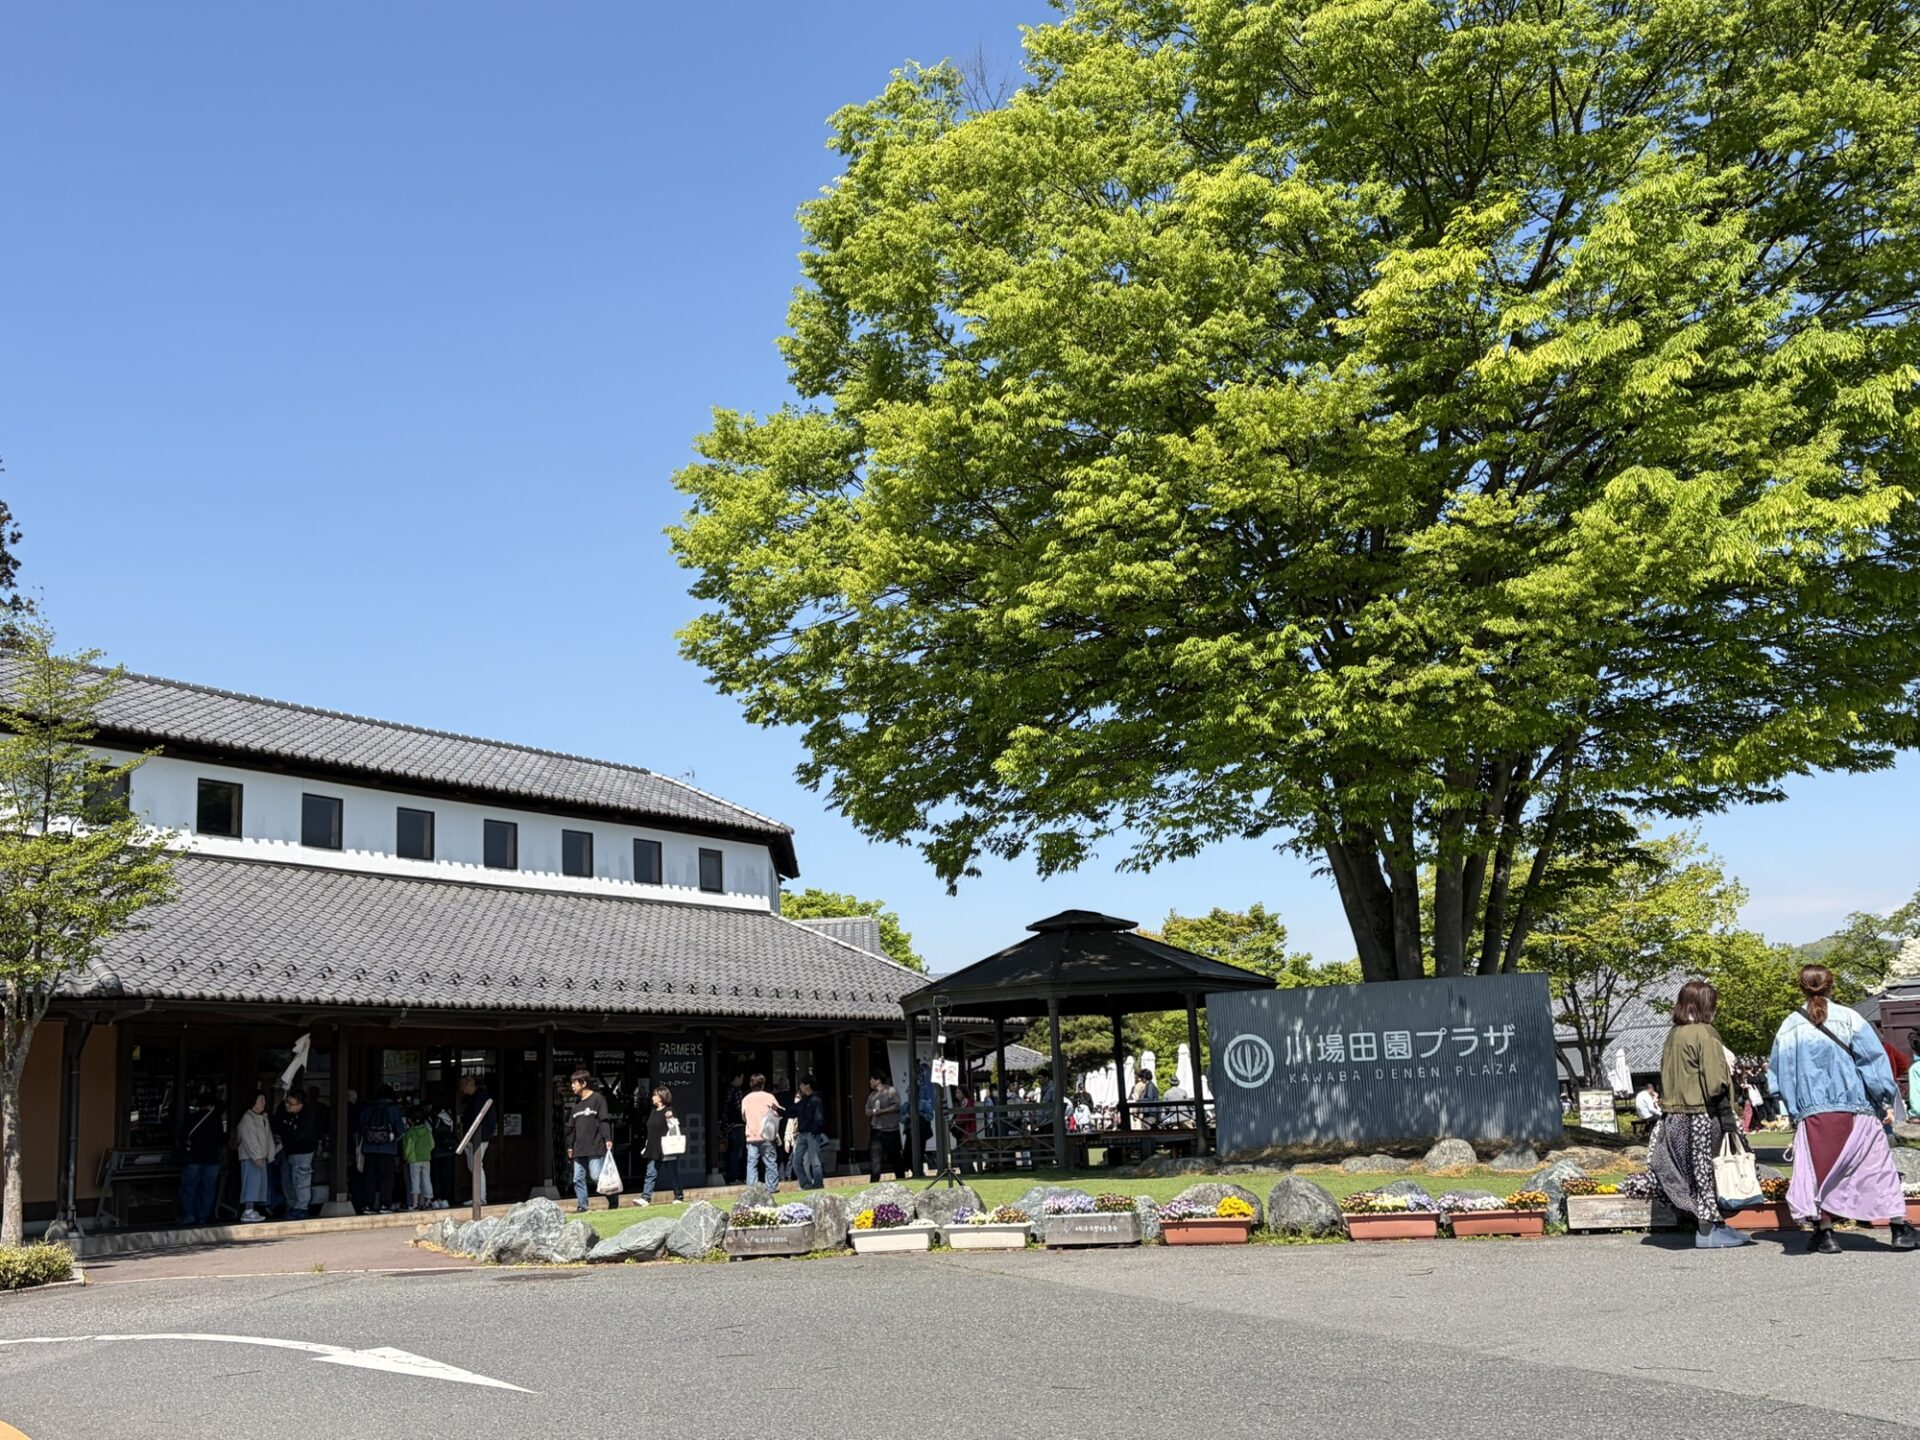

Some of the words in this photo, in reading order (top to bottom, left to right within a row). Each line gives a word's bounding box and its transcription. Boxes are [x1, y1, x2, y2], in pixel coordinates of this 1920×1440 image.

[1285, 1024, 1516, 1065] 川場田園プラザ
[659, 1061, 697, 1074] MARKET
[1289, 1070, 1361, 1084] KAWABA
[1375, 1066, 1440, 1080] DENEN
[1455, 1063, 1518, 1077] PLAZA
